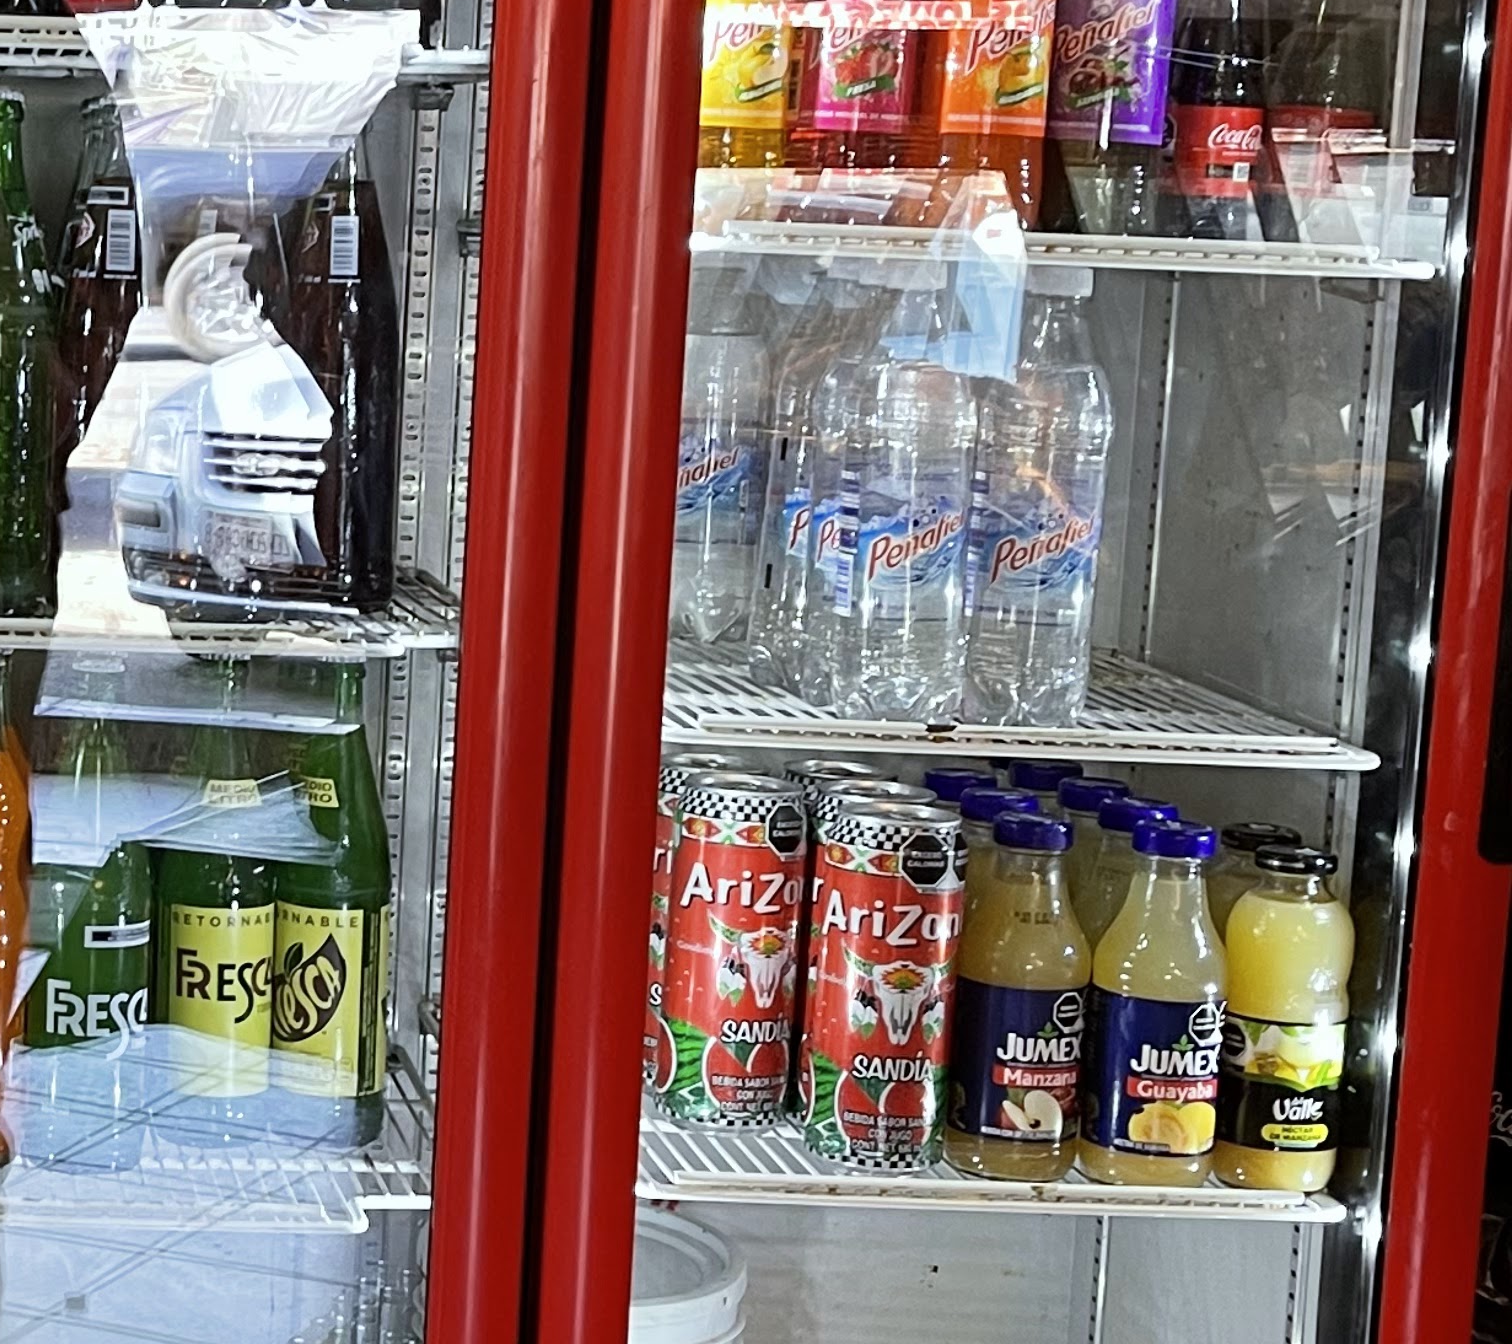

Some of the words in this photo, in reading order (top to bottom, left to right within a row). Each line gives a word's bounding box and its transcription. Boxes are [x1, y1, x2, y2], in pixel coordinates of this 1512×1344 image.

[679, 446, 739, 488] ñafiel
[990, 514, 1095, 584] Peñafiel
[680, 861, 803, 915] AriZo
[172, 910, 271, 928] RETORNAB
[822, 889, 963, 947] AriZon
[996, 1032, 1083, 1063] JUMEX
[1130, 1043, 1221, 1076] JUMEX
[851, 1052, 935, 1083] SANDÍA
[1136, 1080, 1214, 1104] Guayaba
